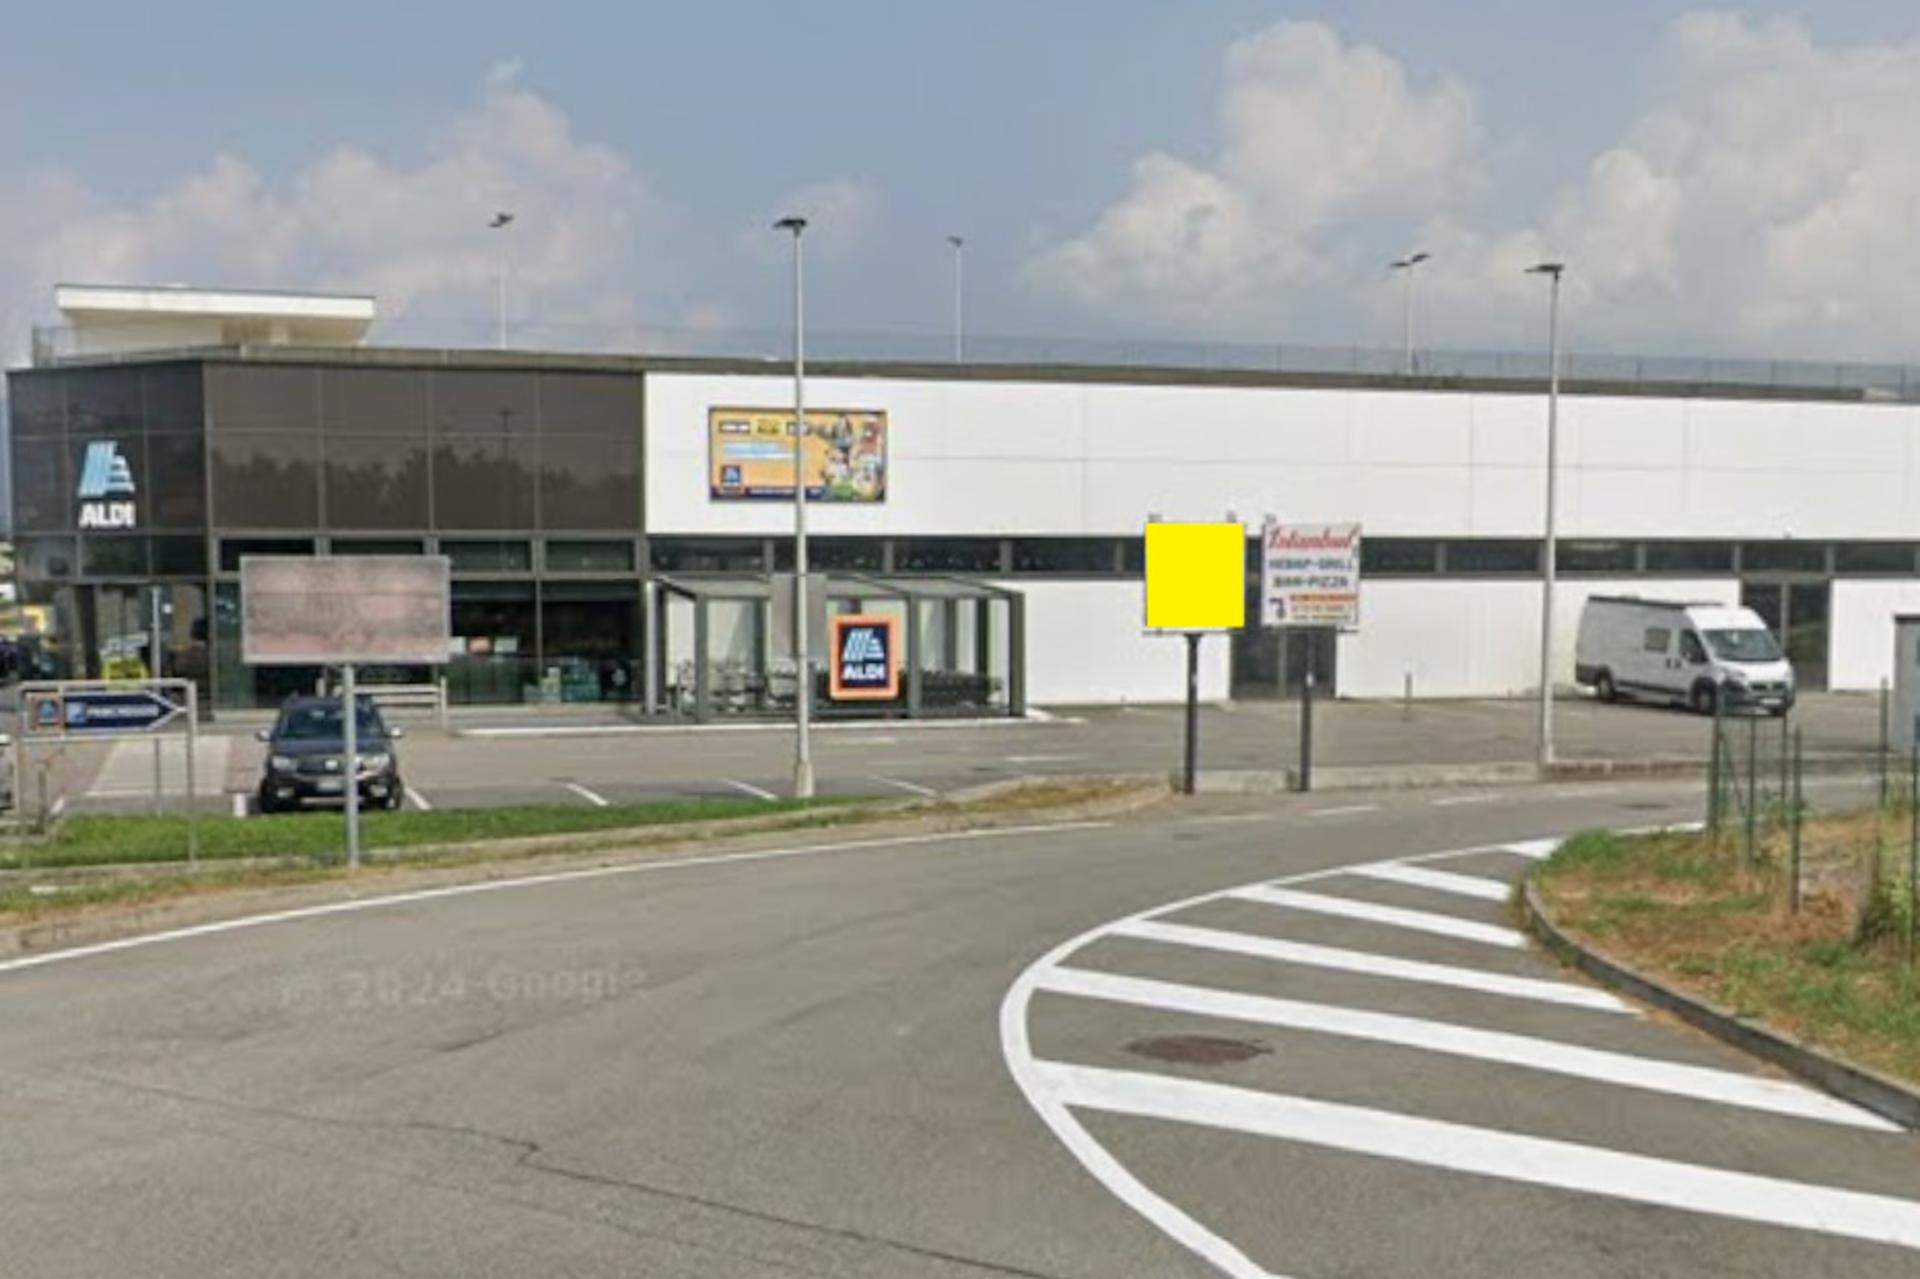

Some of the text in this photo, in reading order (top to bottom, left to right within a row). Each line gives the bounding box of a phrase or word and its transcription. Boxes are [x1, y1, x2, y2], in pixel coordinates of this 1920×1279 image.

[79, 501, 136, 528] ALDI
[1268, 528, 1360, 550] Istanbul
[841, 662, 885, 680] ALDI
